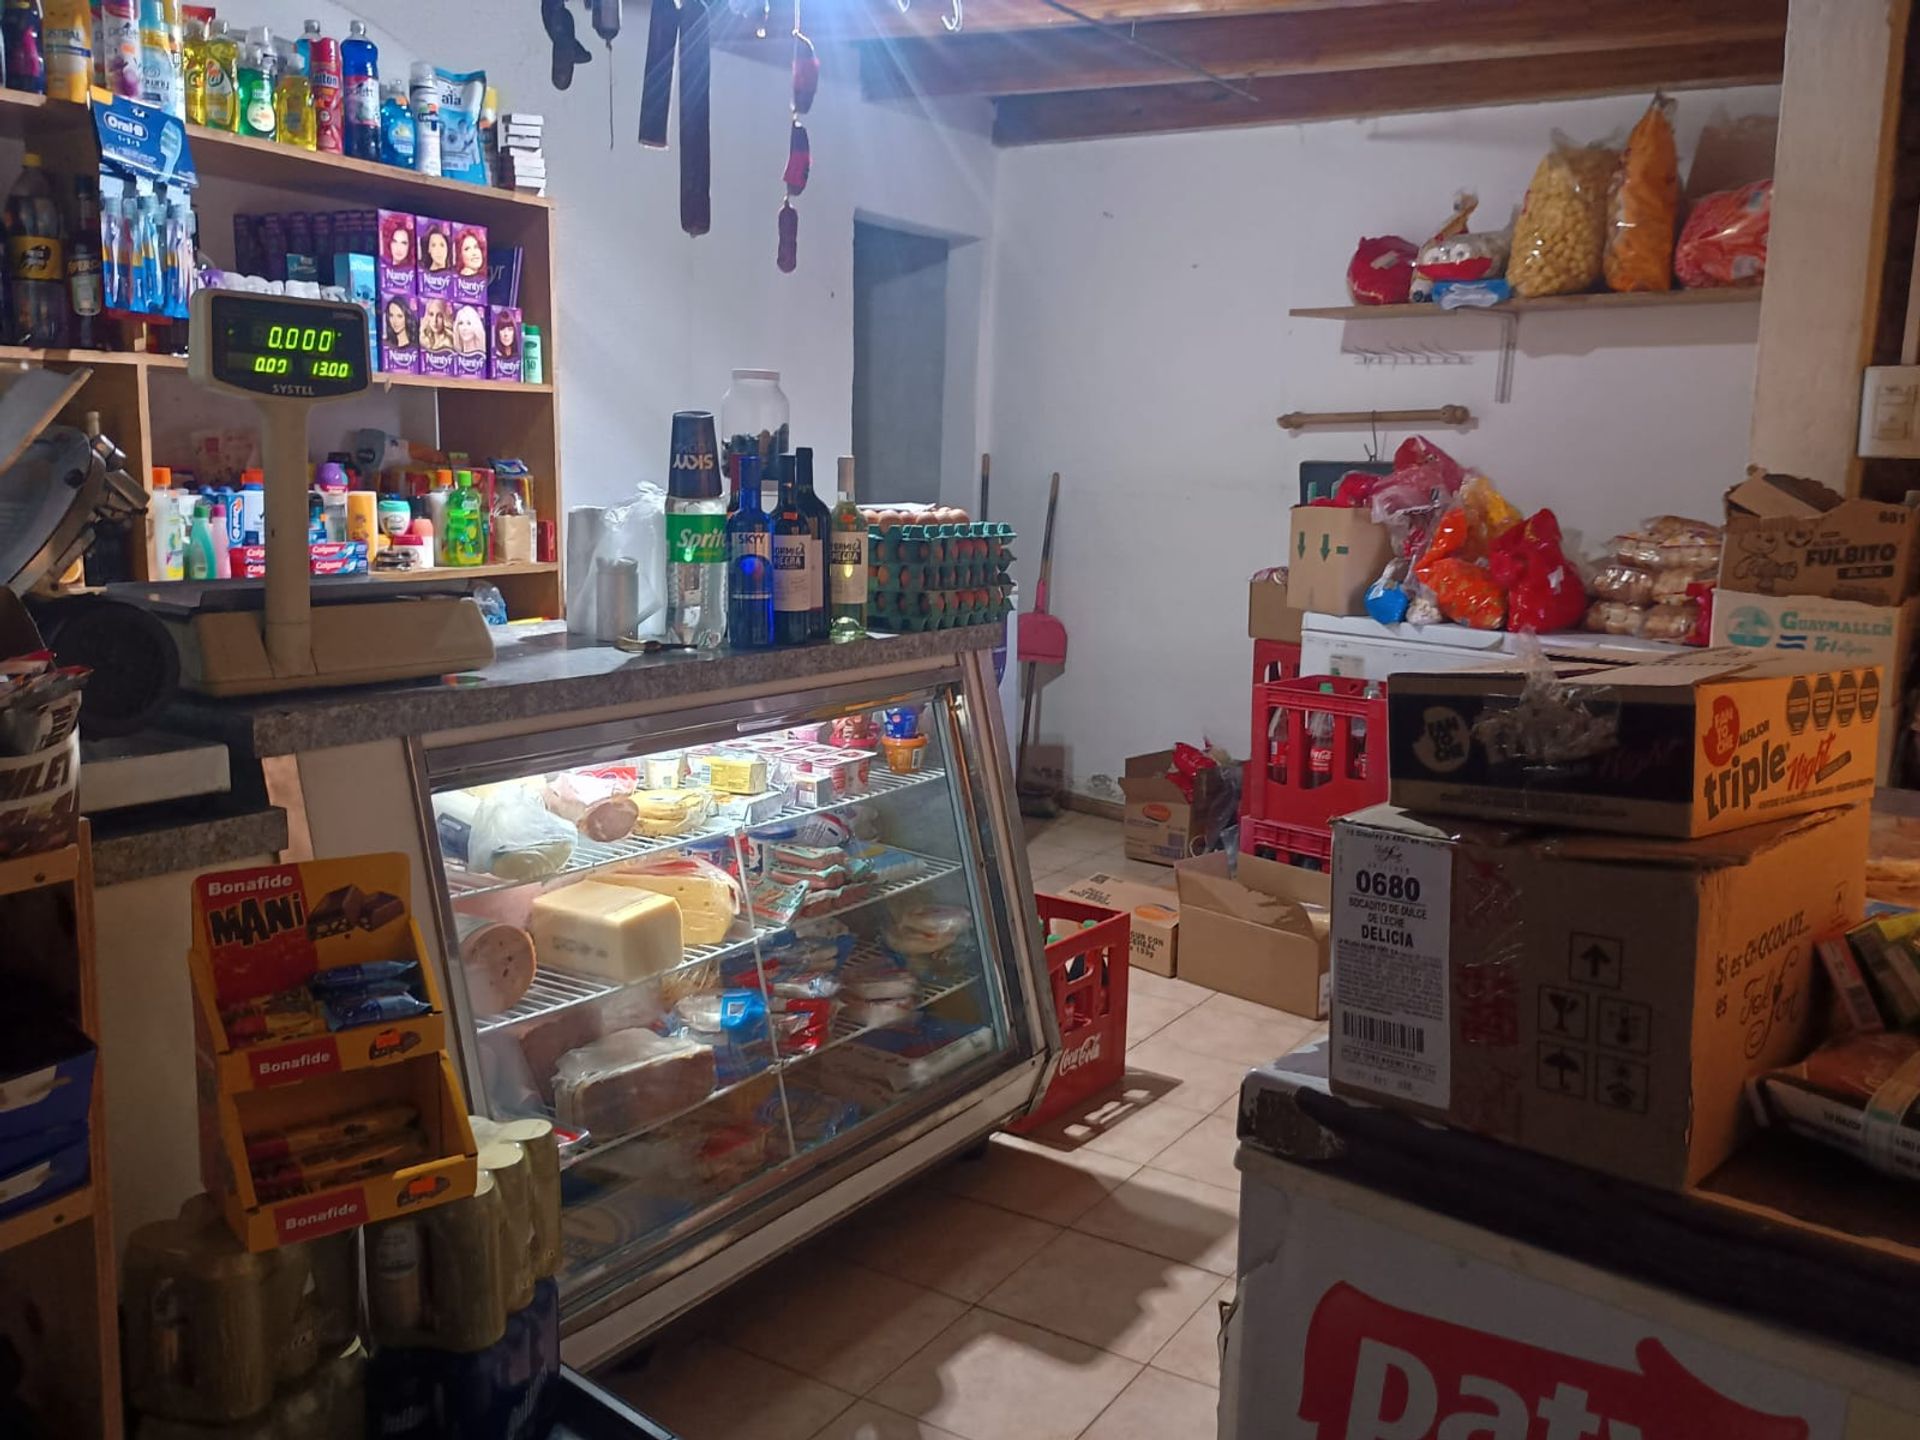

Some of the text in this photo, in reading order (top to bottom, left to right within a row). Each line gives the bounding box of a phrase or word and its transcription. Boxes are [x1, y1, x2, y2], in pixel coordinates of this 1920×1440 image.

[107, 115, 144, 137] Oral-B
[268, 326, 333, 352] 0.000
[272, 383, 315, 396] SYSTEL
[738, 533, 765, 545] SKYY
[1804, 544, 1898, 567] FULBITO
[1704, 739, 1787, 821] triple
[208, 874, 293, 897] Bonafide
[1356, 869, 1421, 902] 0680
[1348, 896, 1428, 920] BOCADITO DE DULCE
[1367, 912, 1405, 929] DE LECHE
[1361, 924, 1414, 948] DELICIA
[259, 1051, 331, 1075] Bonafide
[285, 1202, 358, 1231] Bonafide
